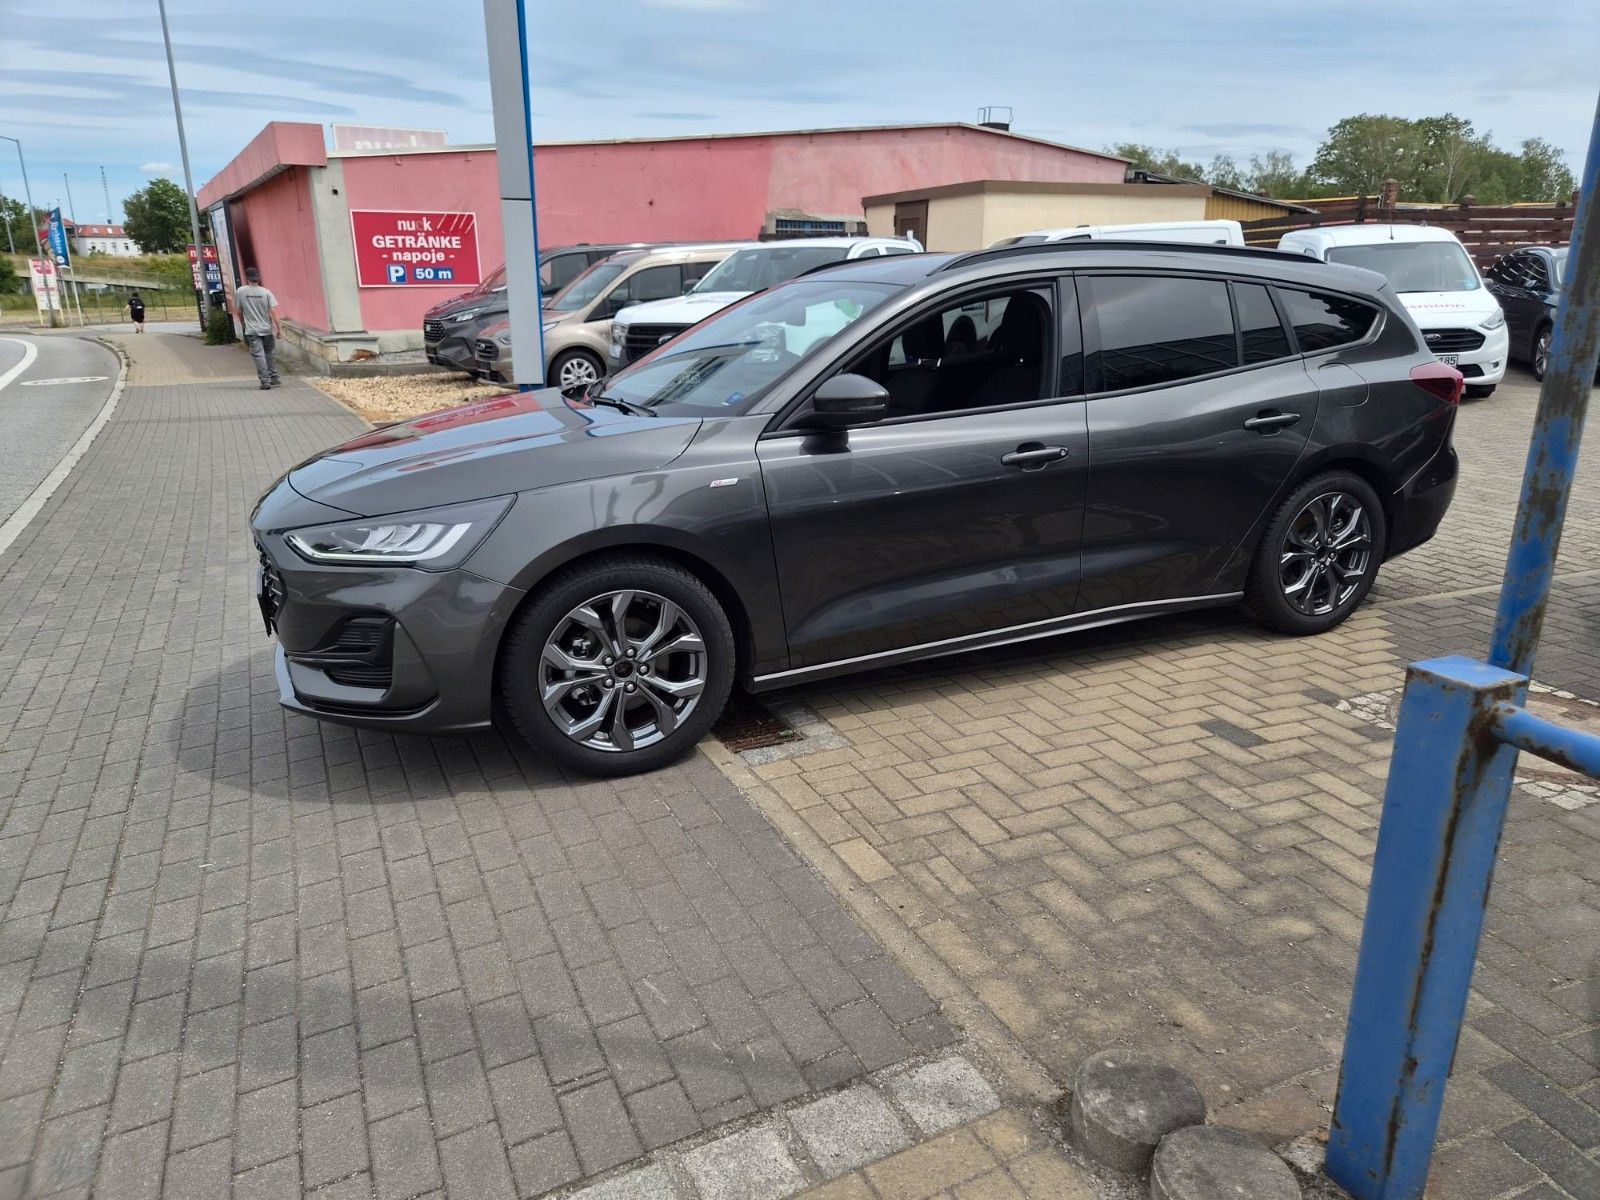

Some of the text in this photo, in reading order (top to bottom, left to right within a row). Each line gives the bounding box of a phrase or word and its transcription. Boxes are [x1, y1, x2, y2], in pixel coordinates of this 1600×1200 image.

[372, 232, 461, 248] GETRÄNKE
[392, 249, 445, 263] napoje
[389, 266, 452, 282] P 50 m
